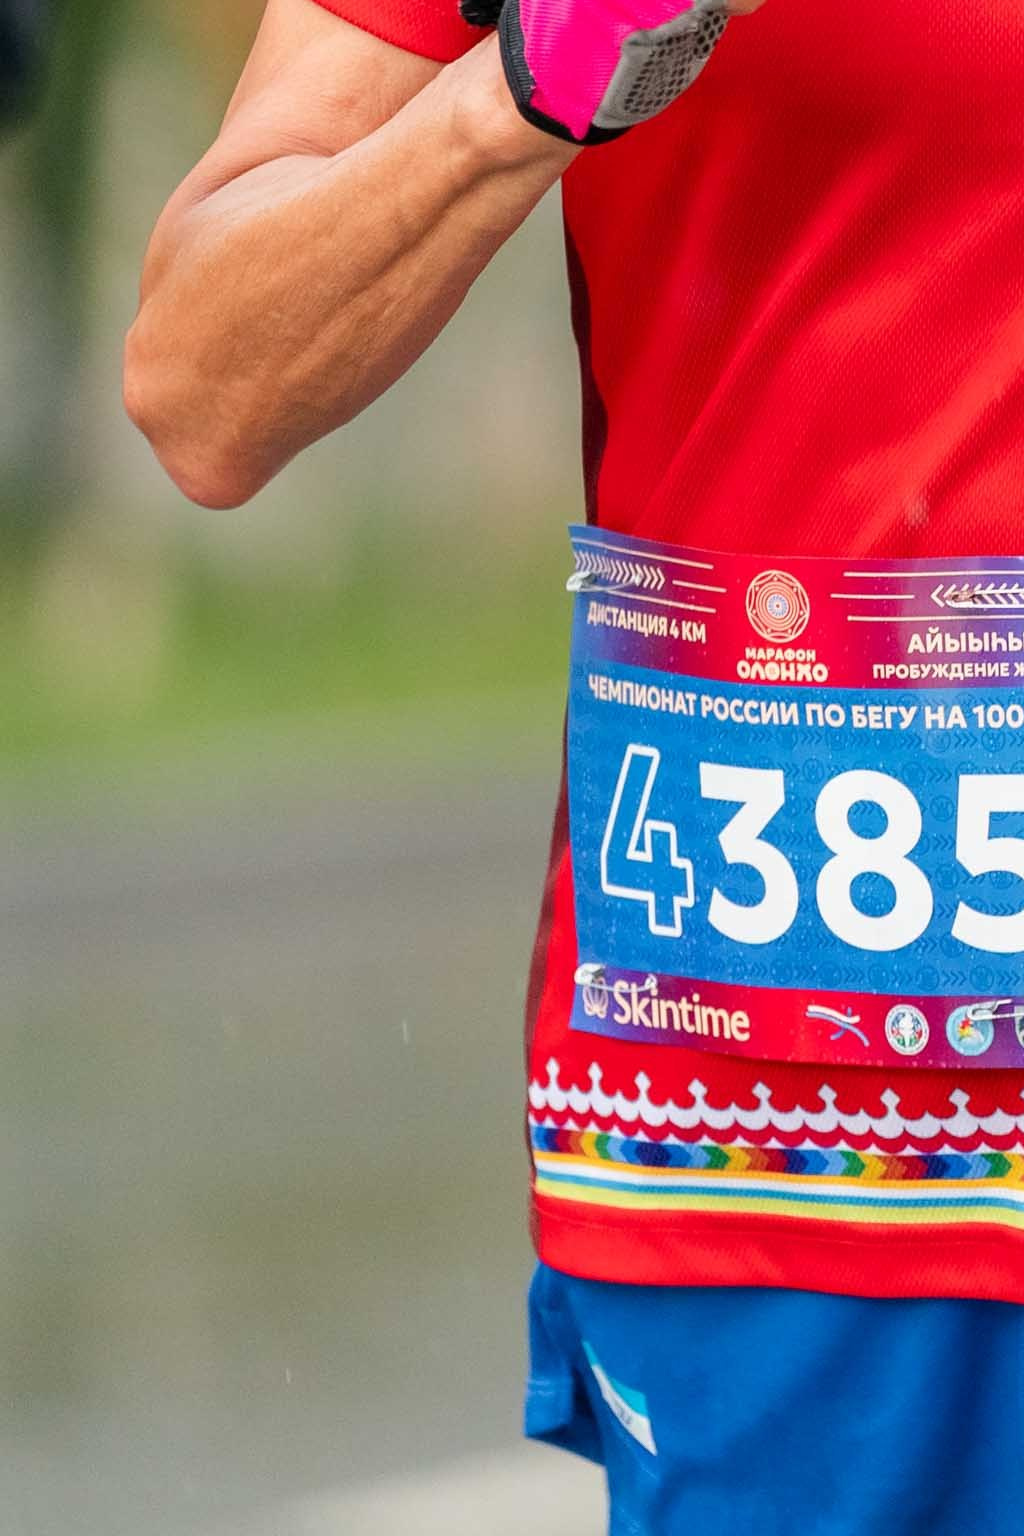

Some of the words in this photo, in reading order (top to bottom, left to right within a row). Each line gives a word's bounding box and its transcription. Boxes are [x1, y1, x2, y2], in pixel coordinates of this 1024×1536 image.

[587, 601, 668, 638] ДИСТАНЦИЯ
[669, 618, 680, 640] 4
[682, 620, 706, 644] КМ
[744, 647, 817, 663] МАРАФОН
[872, 662, 1010, 681] ПРОБУЖДЕНИЕ
[588, 673, 697, 717] ЧЕМПИОНАТ
[701, 694, 800, 726] РОССИИ
[805, 702, 846, 728] ПО
[851, 704, 917, 730] БЕГУ
[924, 704, 968, 729] НА
[972, 703, 1024, 729] 100
[613, 979, 751, 1042] Skintime
